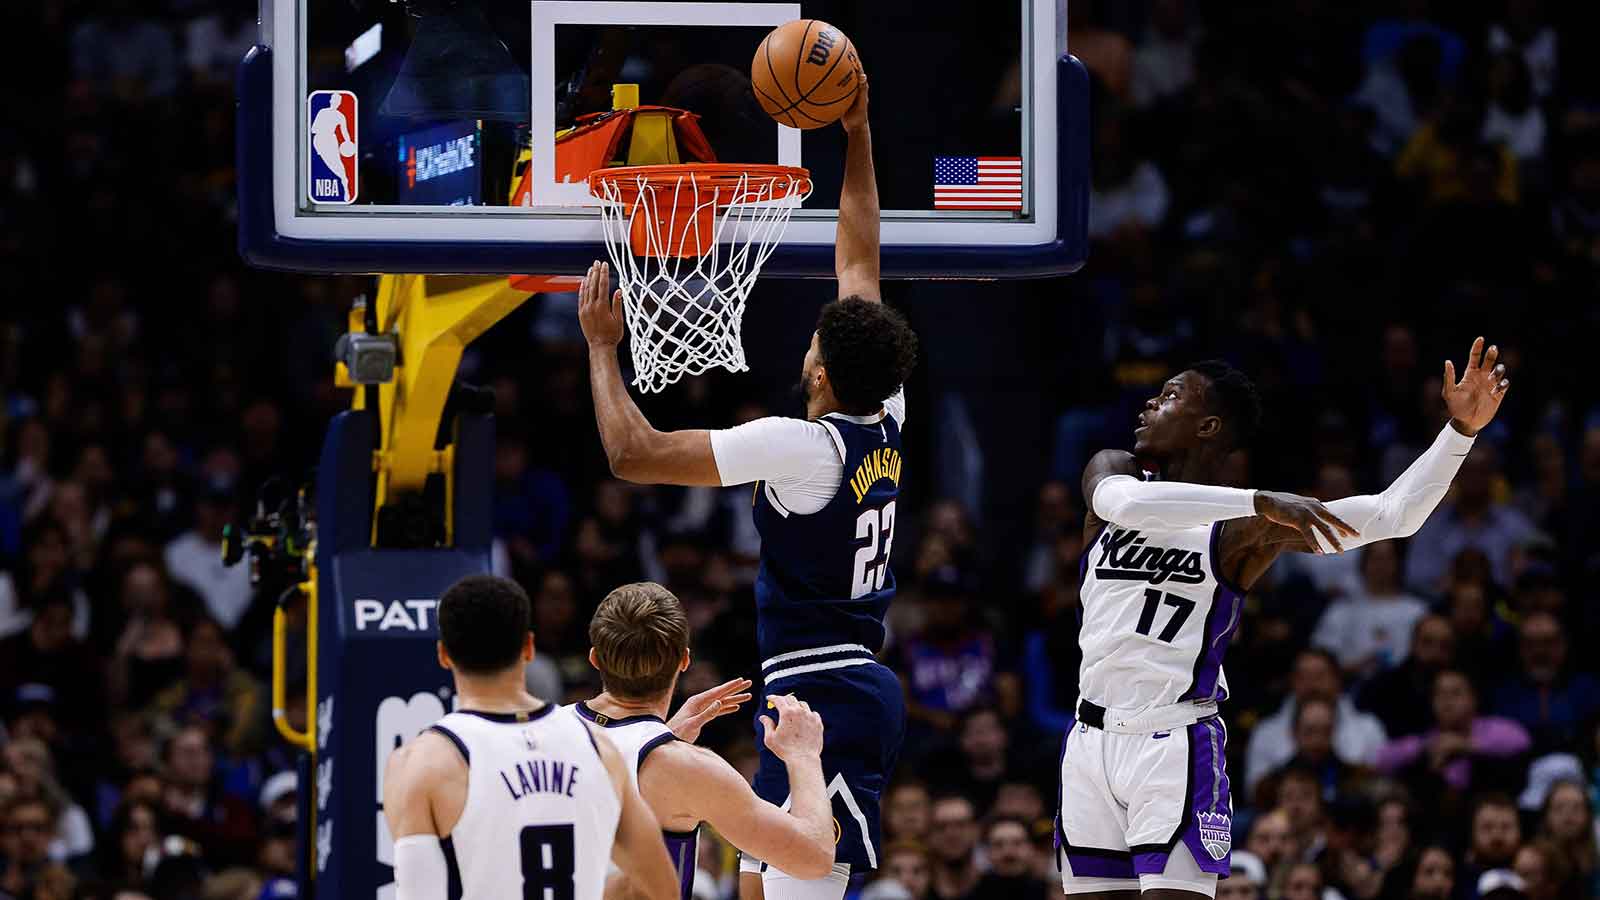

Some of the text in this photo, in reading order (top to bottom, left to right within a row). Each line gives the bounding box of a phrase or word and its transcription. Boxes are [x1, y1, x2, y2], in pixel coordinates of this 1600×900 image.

[806, 31, 835, 66] Wil
[315, 179, 339, 197] NBA
[850, 447, 902, 504] JOHNSON
[851, 500, 896, 600] 23
[1095, 528, 1206, 585] Kings
[354, 599, 441, 631] PAT
[1135, 588, 1196, 643] 17
[500, 759, 579, 800] LAVINE
[1201, 830, 1230, 842] KINGS
[520, 823, 575, 900] 8
